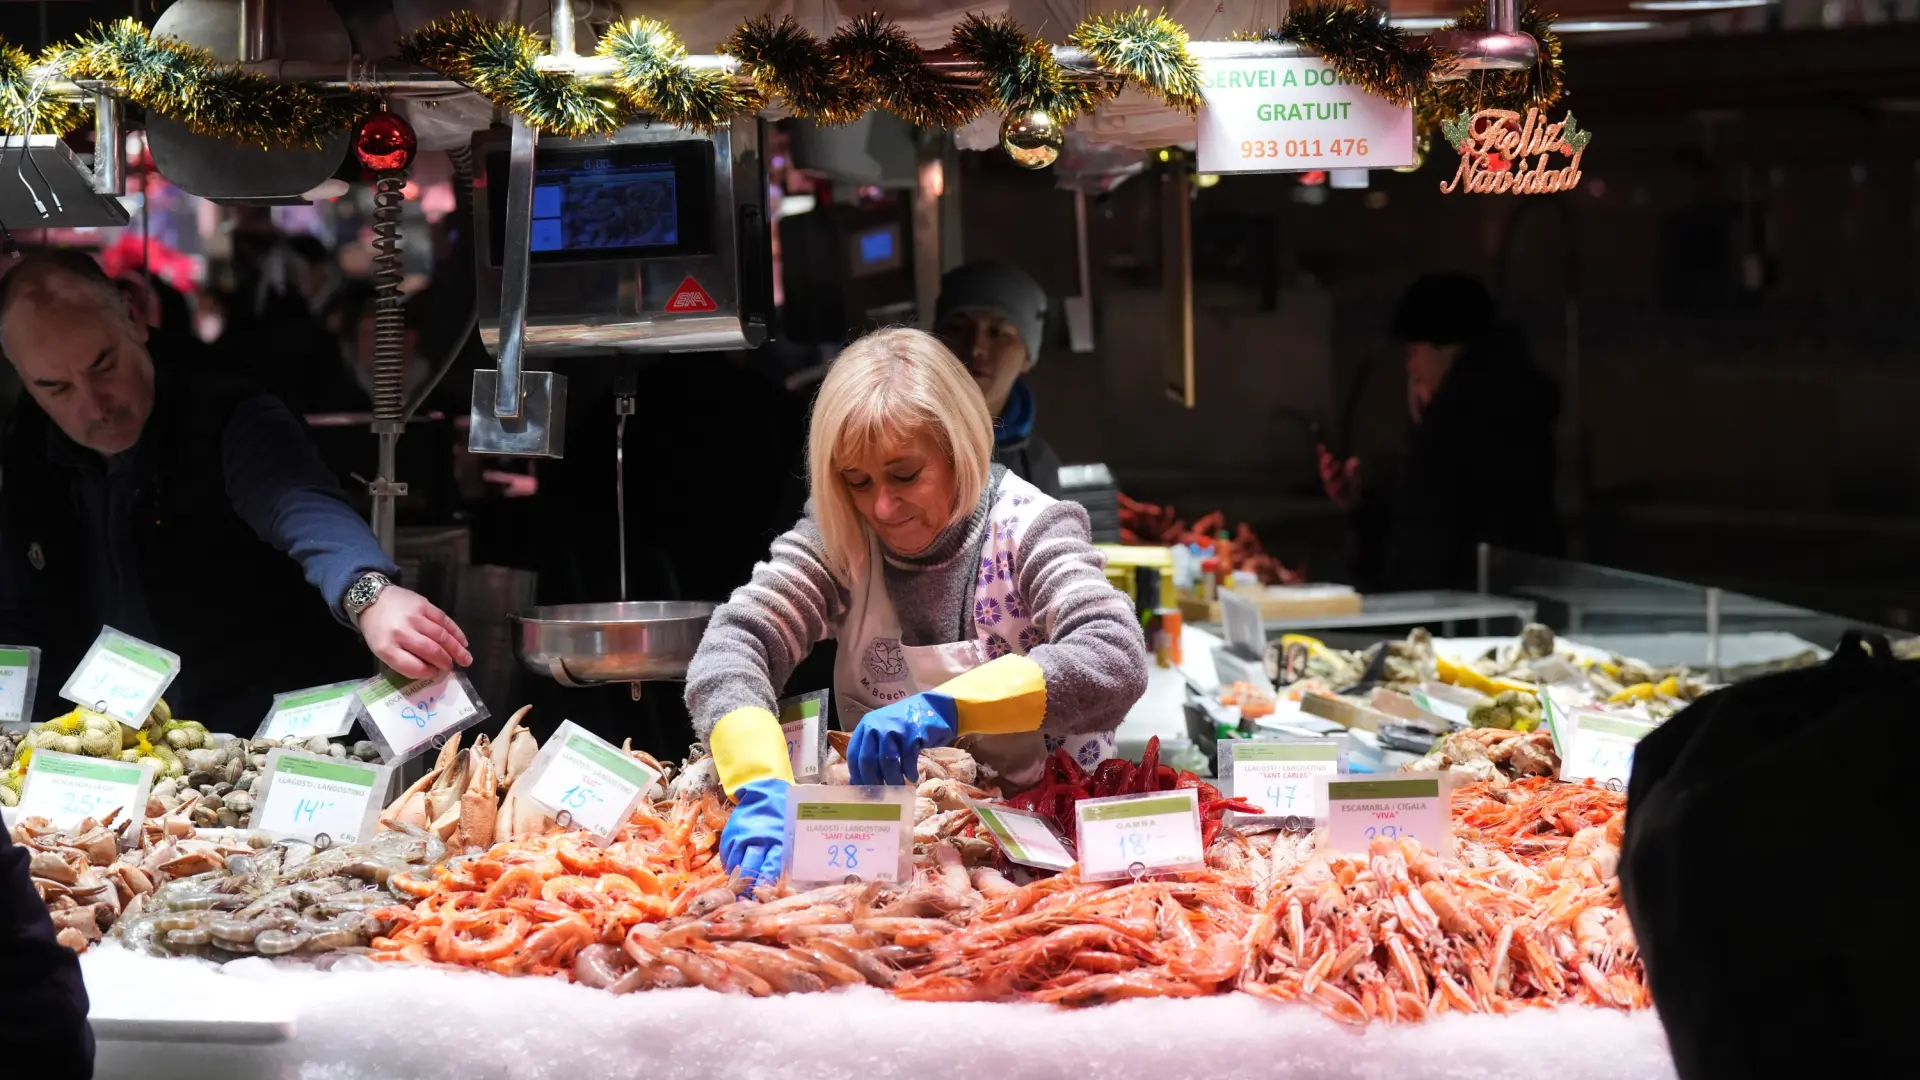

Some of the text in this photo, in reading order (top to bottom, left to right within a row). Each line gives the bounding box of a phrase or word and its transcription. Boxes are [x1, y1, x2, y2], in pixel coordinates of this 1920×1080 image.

[1204, 69, 1276, 89] SERVEI
[1282, 69, 1298, 87] A
[1256, 101, 1352, 122] GRATUIT
[1468, 107, 1568, 161] Feliz
[1240, 138, 1369, 159] 933 011 476
[1439, 150, 1586, 195] Navidad
[673, 291, 708, 308] EXA
[871, 687, 907, 701] Bosch
[318, 783, 365, 797] LANGOSTINO
[1341, 803, 1390, 812] ESCAMARLA
[1396, 802, 1427, 811] CIGALA
[1371, 811, 1400, 820] "VIVA"
[844, 824, 891, 833] LANGOSTINO
